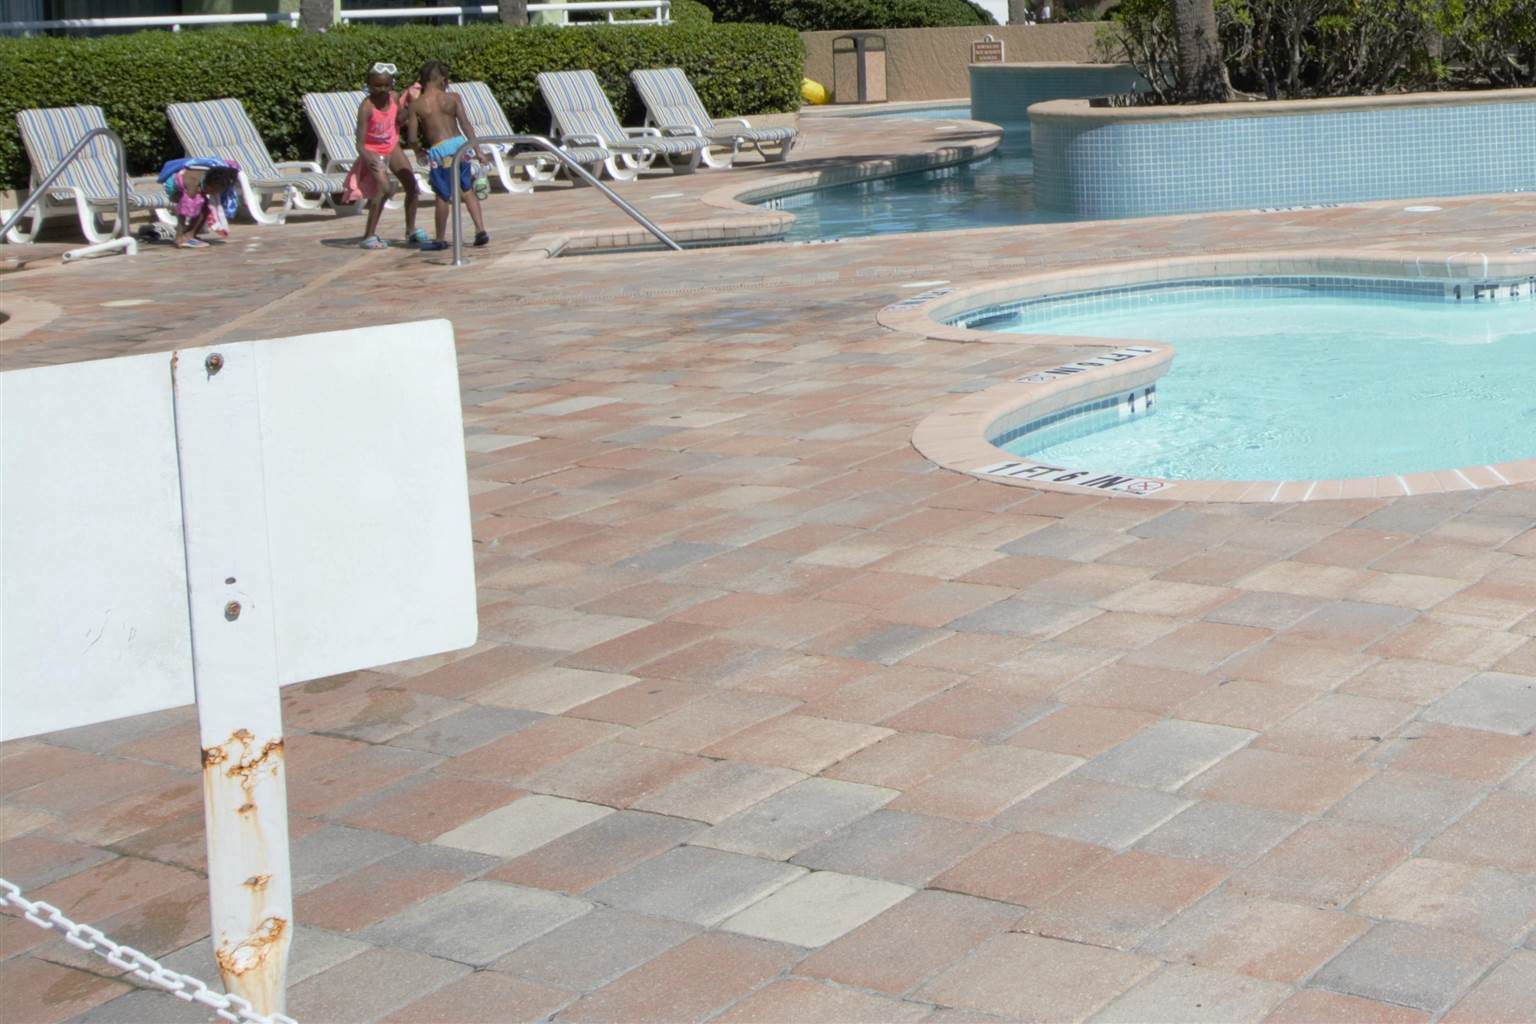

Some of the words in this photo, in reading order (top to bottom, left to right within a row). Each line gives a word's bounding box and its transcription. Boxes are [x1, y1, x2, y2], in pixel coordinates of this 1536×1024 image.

[1453, 284, 1461, 300] 1
[1473, 284, 1499, 299] FT
[1097, 353, 1137, 362] FT
[1044, 366, 1087, 375] IN
[1128, 392, 1135, 414] 1
[987, 462, 1022, 474] 1
[1008, 465, 1066, 479] FT
[1053, 471, 1089, 482] 6
[1078, 475, 1134, 489] IN
